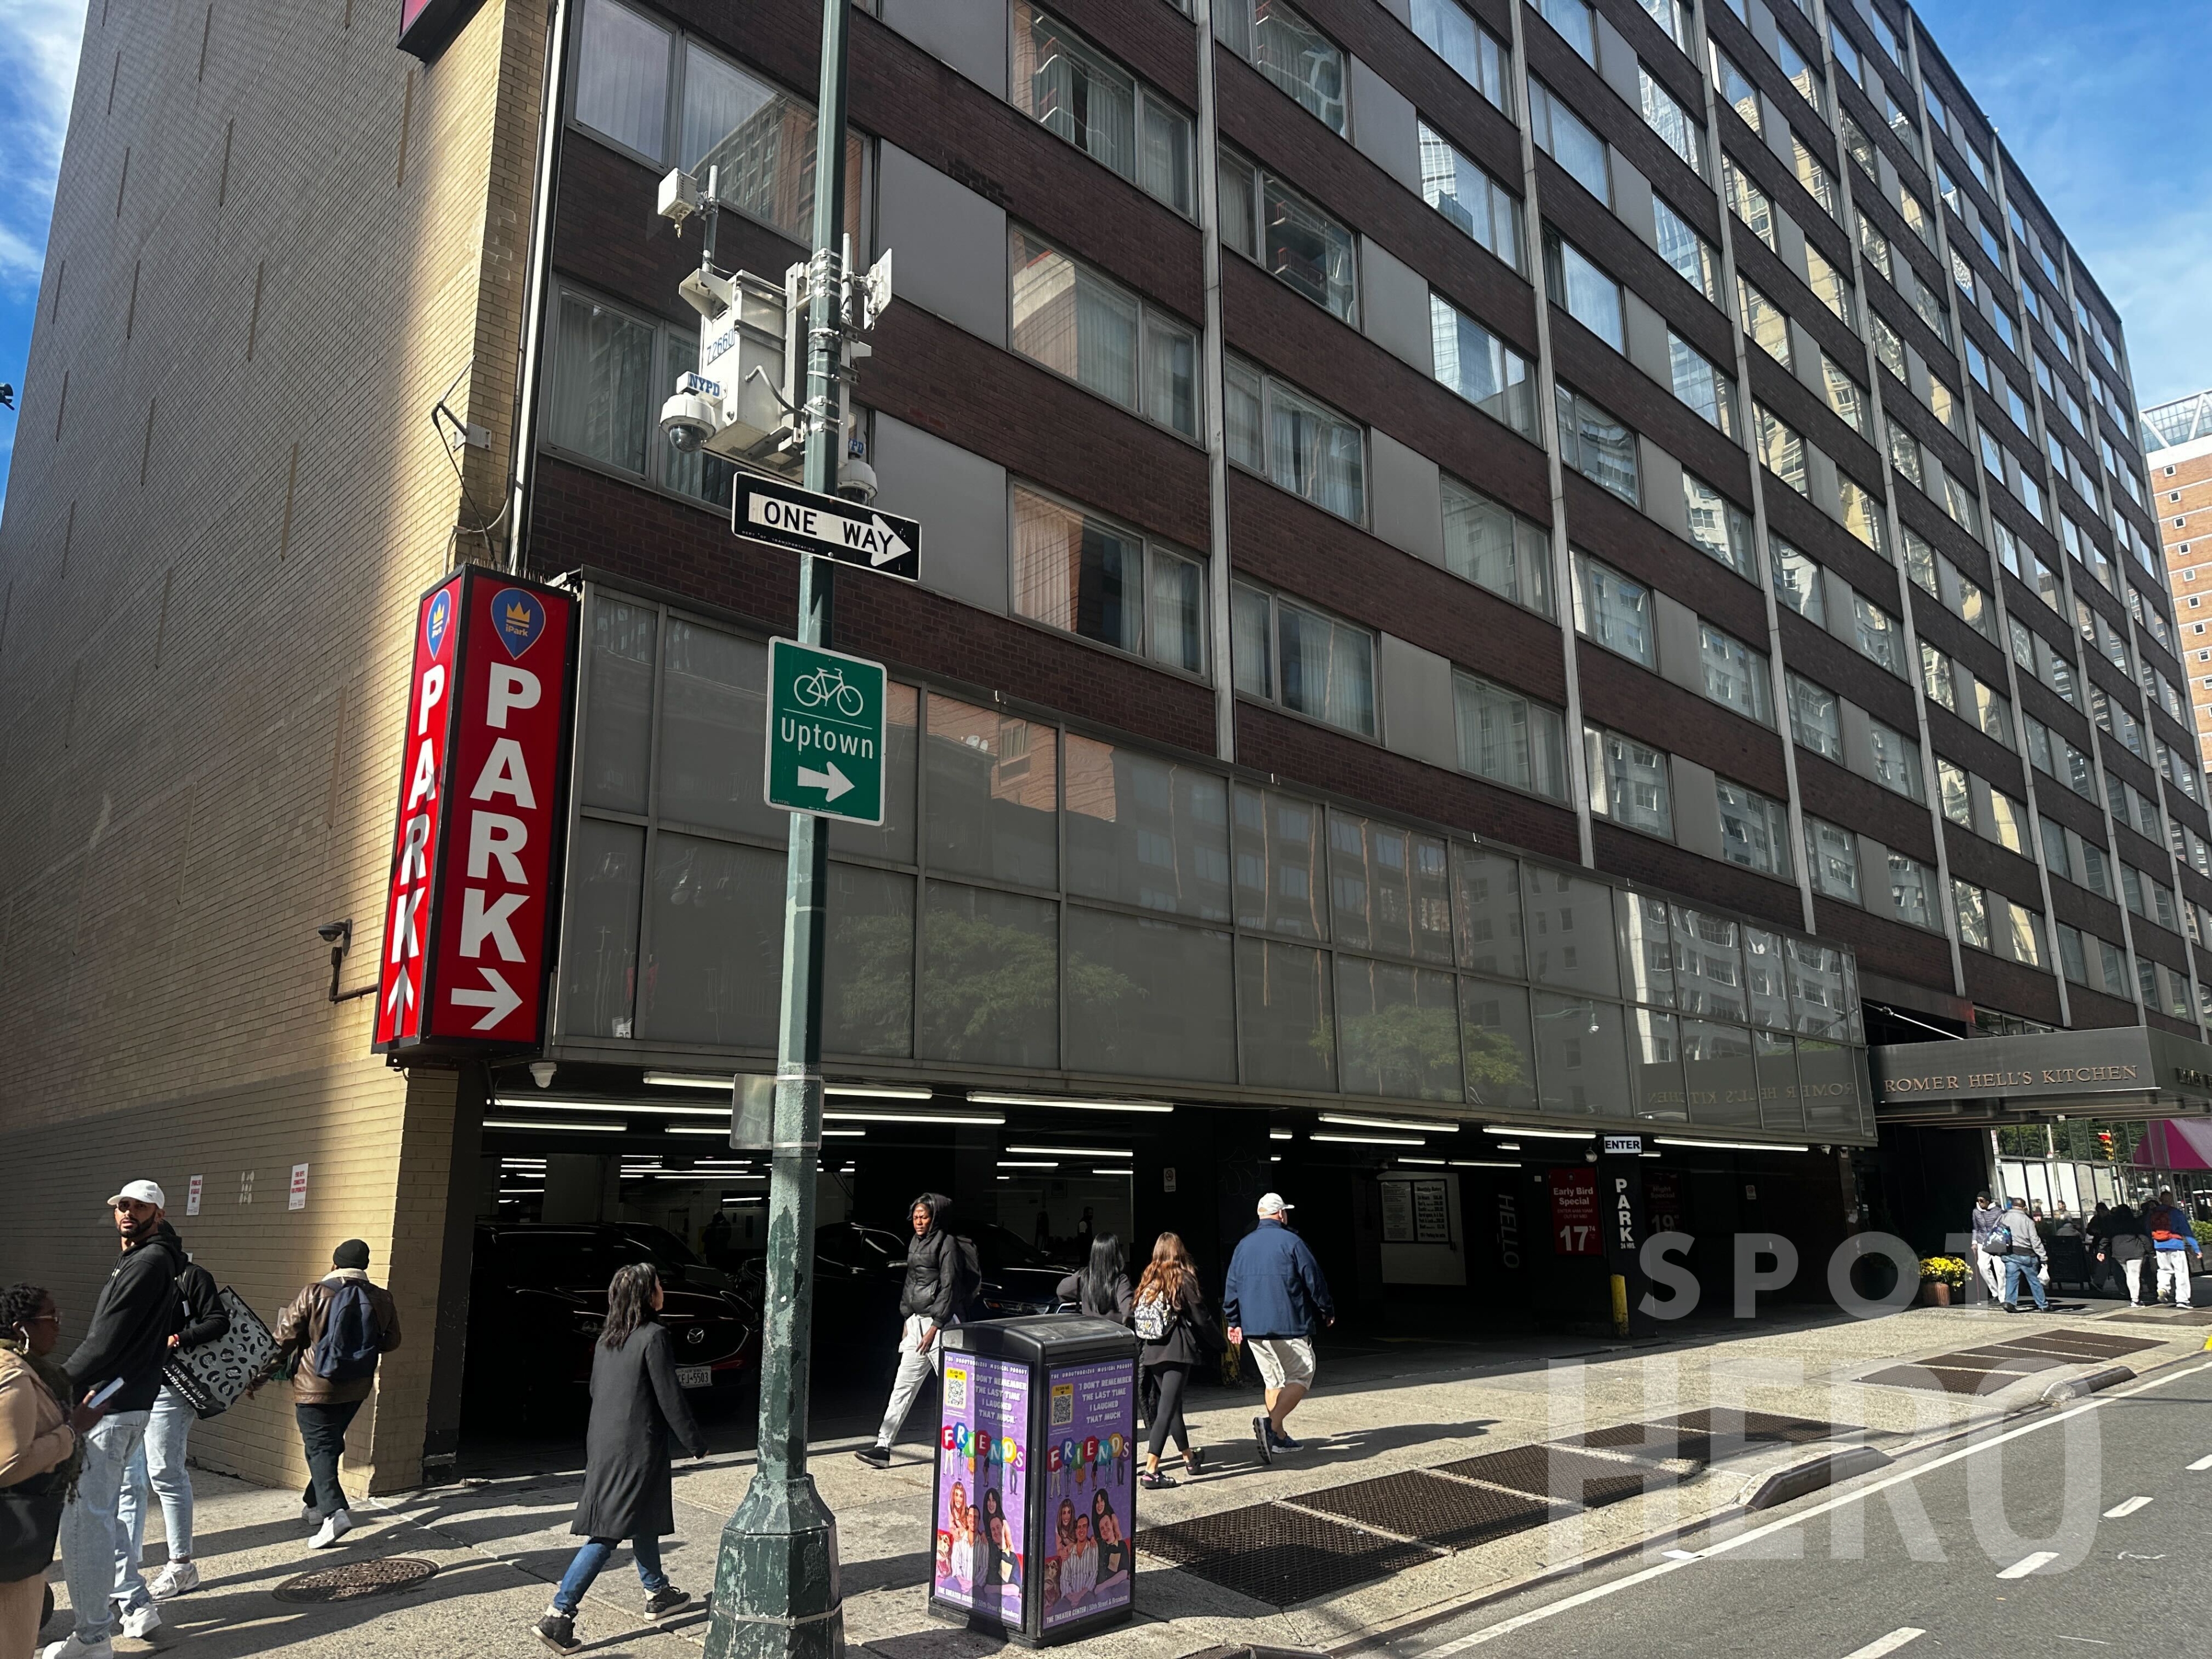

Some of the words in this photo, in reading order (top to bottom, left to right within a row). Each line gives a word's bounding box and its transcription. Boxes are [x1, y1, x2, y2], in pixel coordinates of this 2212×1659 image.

[689, 373, 720, 397] NYPD
[764, 501, 817, 535] ONE
[843, 521, 893, 554] WAY
[506, 624, 528, 637] iPark
[782, 717, 873, 759] Uptown
[391, 664, 444, 964] PARK
[459, 661, 541, 963] PARK
[1885, 1077, 1960, 1093] ROMER
[1968, 1071, 2032, 1088] HELL'S
[2042, 1065, 2138, 1084] KITCHEN
[1605, 1141, 1640, 1149] ENTER
[1553, 1187, 1574, 1197] Early
[1576, 1187, 1594, 1195] Bird
[1650, 1191, 1676, 1200] Special
[1559, 1196, 1589, 1207] Special
[1615, 1179, 1634, 1242] PARK
[1498, 1193, 1519, 1269] HELLO
[1559, 1225, 1588, 1251] 17
[171, 1364, 188, 1381] DEALS
[990, 1363, 1009, 1372] MUSICAL
[1062, 1369, 1094, 1378] UNAUTHORIZED
[976, 1374, 993, 1384] DON'T
[994, 1376, 1027, 1391] REMEMBER
[1083, 1381, 1100, 1389] DON'T
[1101, 1376, 1132, 1385] REMEMBER
[975, 1385, 986, 1394] THE
[987, 1388, 1003, 1397] LAST
[1005, 1391, 1020, 1401] TIME
[1082, 1393, 1094, 1402] THE
[1095, 1390, 1111, 1400] LAST
[1112, 1388, 1126, 1397] TIME
[986, 1399, 1012, 1411] LAUGHED
[1093, 1400, 1119, 1411] LAUGHED
[979, 1409, 995, 1419] THAT
[1086, 1414, 1103, 1424] THAT
[945, 1425, 1024, 1468] FRIENDS
[1051, 1437, 1130, 1468] FRIENDS
[945, 1589, 961, 1600] THEATER
[961, 1593, 976, 1604] CENTER
[987, 1602, 998, 1611] Street
[1055, 1611, 1071, 1621] THEATER
[1072, 1606, 1086, 1616] CENTER
[1097, 1600, 1108, 1608] Street
[1112, 1595, 1128, 1604] Broadway
